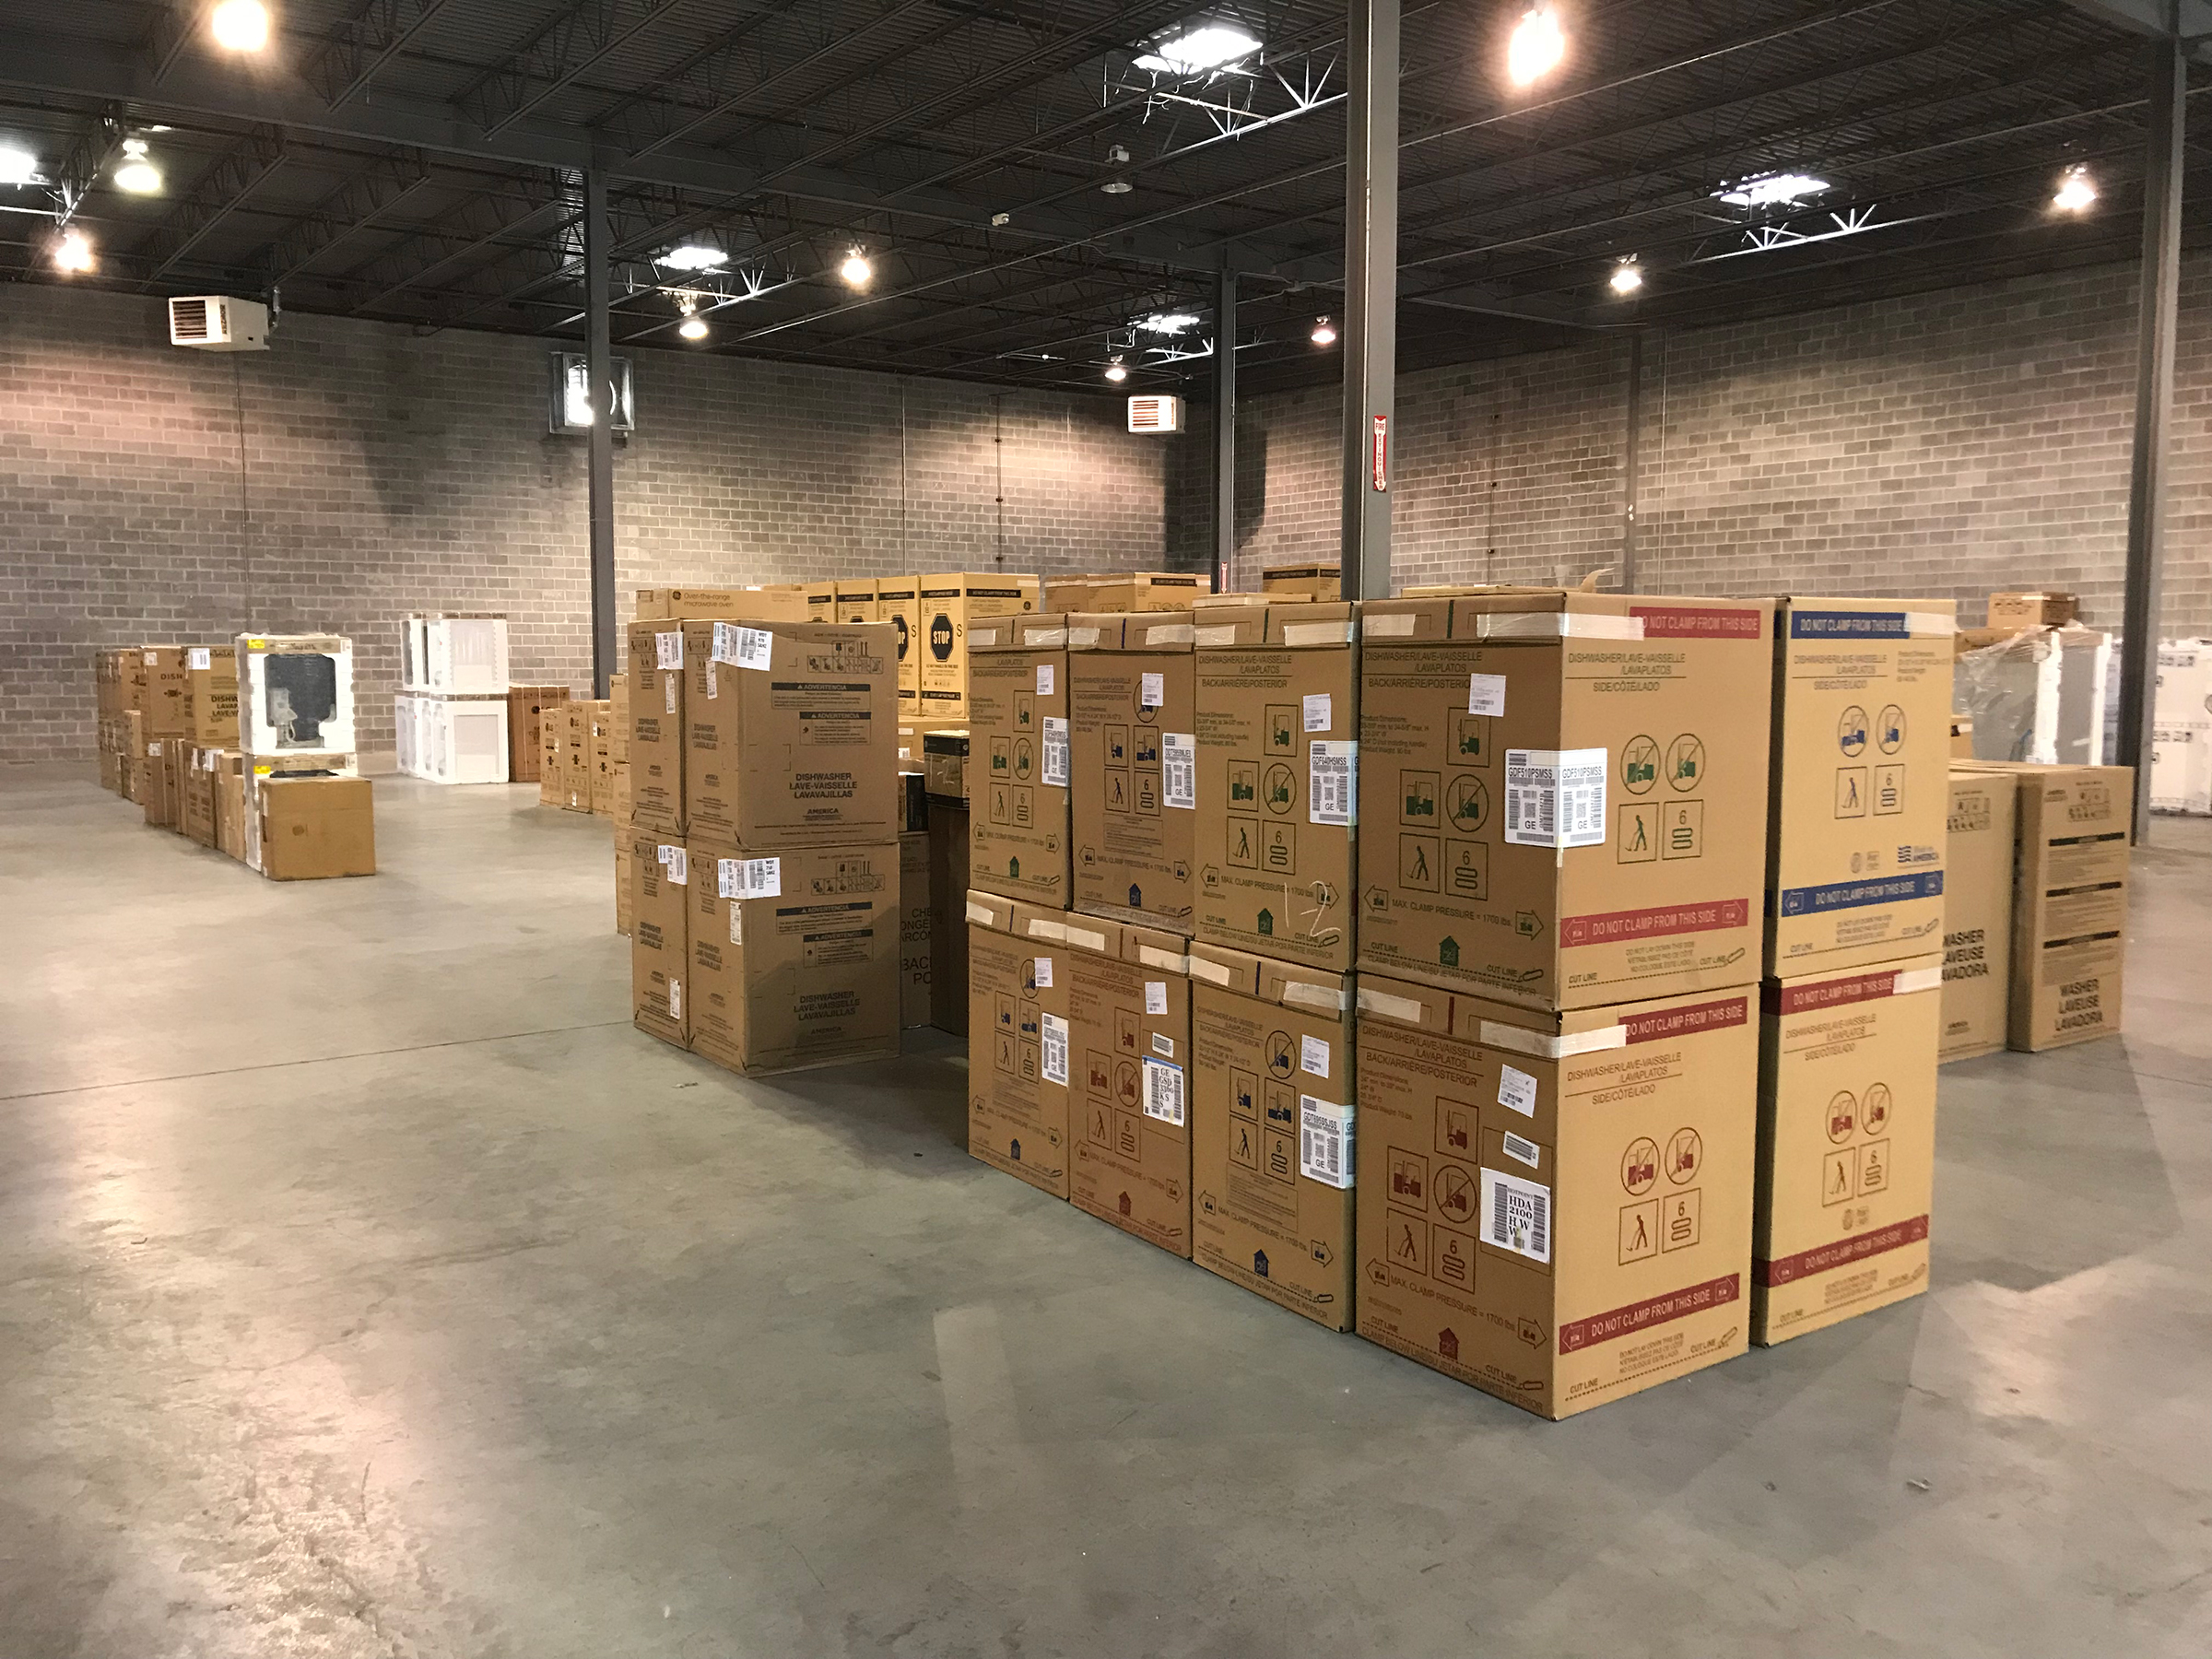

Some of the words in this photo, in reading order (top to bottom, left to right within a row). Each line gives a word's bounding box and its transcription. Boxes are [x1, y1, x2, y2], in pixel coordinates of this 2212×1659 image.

[912, 624, 916, 638] S
[912, 625, 916, 637] S
[957, 623, 962, 637] S
[1650, 617, 1667, 629] NOT
[1668, 617, 1697, 629] CLAMP
[1697, 618, 1720, 630] FROM
[1722, 618, 1739, 631] THIS
[1740, 618, 1759, 631] SIDE
[1800, 619, 1812, 631] DO
[1813, 619, 1827, 631] NOT
[1828, 619, 1852, 631] CLAMP
[1852, 619, 1871, 631] FROM
[1872, 619, 1887, 631] THIS
[1888, 619, 1903, 631] SIDE
[933, 630, 950, 644] STOP
[1198, 655, 1292, 664] DISHWASHER/LAVE-VAISSELLE
[1364, 652, 1482, 662] DISHWASHER/LAVE-VAISSELLE
[1568, 653, 1686, 664] DISHWASHER/LAVE-VAISSELLE
[1239, 665, 1279, 674] /LAVAPLATOS
[1415, 663, 1466, 673] /LAVAPLATOS
[1621, 665, 1672, 675] /LAVAPLATOS
[796, 772, 852, 781] DISHWASHER
[1509, 767, 1552, 779] GDF510PSMSS
[1562, 766, 1602, 779] GDF510PSMSS
[1886, 773, 1892, 785] 6
[790, 782, 857, 790] LAVE-VAISSELLE
[1144, 779, 1148, 790] 6
[1678, 810, 1687, 824] 6
[1525, 821, 1535, 830] GE
[1578, 820, 1587, 830] GE
[1276, 830, 1282, 843] 6
[1462, 851, 1471, 865] 6
[1235, 877, 1253, 887] CLAMP
[1254, 882, 1286, 892] PRESSURE
[1816, 893, 1825, 905] DO
[1827, 891, 1841, 904] NOT
[1841, 888, 1864, 902] CLAMP
[1864, 886, 1884, 899] FROM
[1885, 882, 1899, 896] THIS
[1900, 881, 1915, 893] SIDE
[1410, 902, 1434, 912] CLAMP
[1435, 905, 1474, 920] PRESSURE
[1483, 914, 1499, 924] 1700
[1593, 923, 1606, 935] DO
[1606, 920, 1623, 935] NOT
[1625, 918, 1653, 932] CLAMP
[1654, 914, 1677, 928] FROM
[1678, 912, 1696, 925] THIS
[1698, 910, 1716, 923] SIDE
[820, 932, 862, 940] ADVERTENCIA
[1943, 929, 1985, 948] WASHER
[1371, 942, 1383, 950] CUT
[1384, 944, 1398, 953] LINE
[902, 956, 931, 971] BAC
[1487, 964, 1500, 973] CUT
[1502, 967, 1518, 977] LINE
[1568, 974, 1582, 983] CUT
[1583, 972, 1597, 982] LINE
[1794, 993, 1804, 1006] DO
[1805, 990, 1818, 1004] NOT
[1820, 987, 1842, 1001] CLAMP
[1843, 984, 1862, 998] FROM
[1864, 981, 1877, 994] THIS
[1878, 978, 1892, 991] SIDE
[2059, 979, 2100, 997] WASHER
[800, 991, 854, 1003] DISHWASHER
[2058, 994, 2100, 1014] LAVEUSE
[794, 998, 860, 1013] LAVE-VAISSELLE
[799, 1007, 855, 1020] LAVAVAJILLAS
[2054, 1010, 2103, 1031] LAVADORA
[1626, 1024, 1637, 1037] DO
[1639, 1020, 1656, 1033] NOT
[1656, 1017, 1683, 1031] CLAMP
[1685, 1012, 1706, 1027] FROM
[1707, 1008, 1724, 1023] THIS
[1725, 1005, 1743, 1018] SIDE
[1362, 1025, 1483, 1061] DISHWASHER/LAVE-VAISSELLE
[1414, 1049, 1467, 1068] /LAVAPLATOS
[1161, 1068, 1170, 1077] GE
[1567, 1052, 1681, 1082] DISHWASHER/LAVE-VAISSELLE
[1159, 1076, 1171, 1086] GSD
[1619, 1066, 1668, 1083] /LAVAPLATOS
[1124, 1120, 1131, 1132] 6
[1277, 1141, 1282, 1152] 6
[1315, 1159, 1324, 1168] GE
[1510, 1195, 1532, 1211] HDA
[1678, 1201, 1685, 1216] 6
[1510, 1206, 1532, 1219] 2100
[1510, 1216, 1516, 1227] H
[1520, 1219, 1529, 1230] W
[1509, 1226, 1517, 1238] W
[1450, 1240, 1458, 1254] 6
[1409, 1282, 1434, 1298] CLAMP
[1436, 1291, 1477, 1316] PRESSURE
[1487, 1313, 1503, 1327] 1700
[1592, 1324, 1604, 1337] DO
[1605, 1318, 1622, 1334] NOT
[1623, 1308, 1650, 1328] CLAMP
[1651, 1300, 1673, 1318] FROM
[1675, 1295, 1691, 1312] THIS
[1693, 1289, 1711, 1304] SIDE
[1371, 1316, 1385, 1327] CUT
[1385, 1322, 1398, 1333] LINE
[1690, 1343, 1702, 1353] CUT
[1385, 1337, 1410, 1353] BELOW
[1463, 1368, 1478, 1382] POR
[1505, 1384, 1543, 1412] INFERIOR
[1486, 1365, 1500, 1377] CUT
[1500, 1371, 1517, 1382] LINE
[1570, 1383, 1583, 1394] CUT
[1584, 1377, 1598, 1390] LINE
